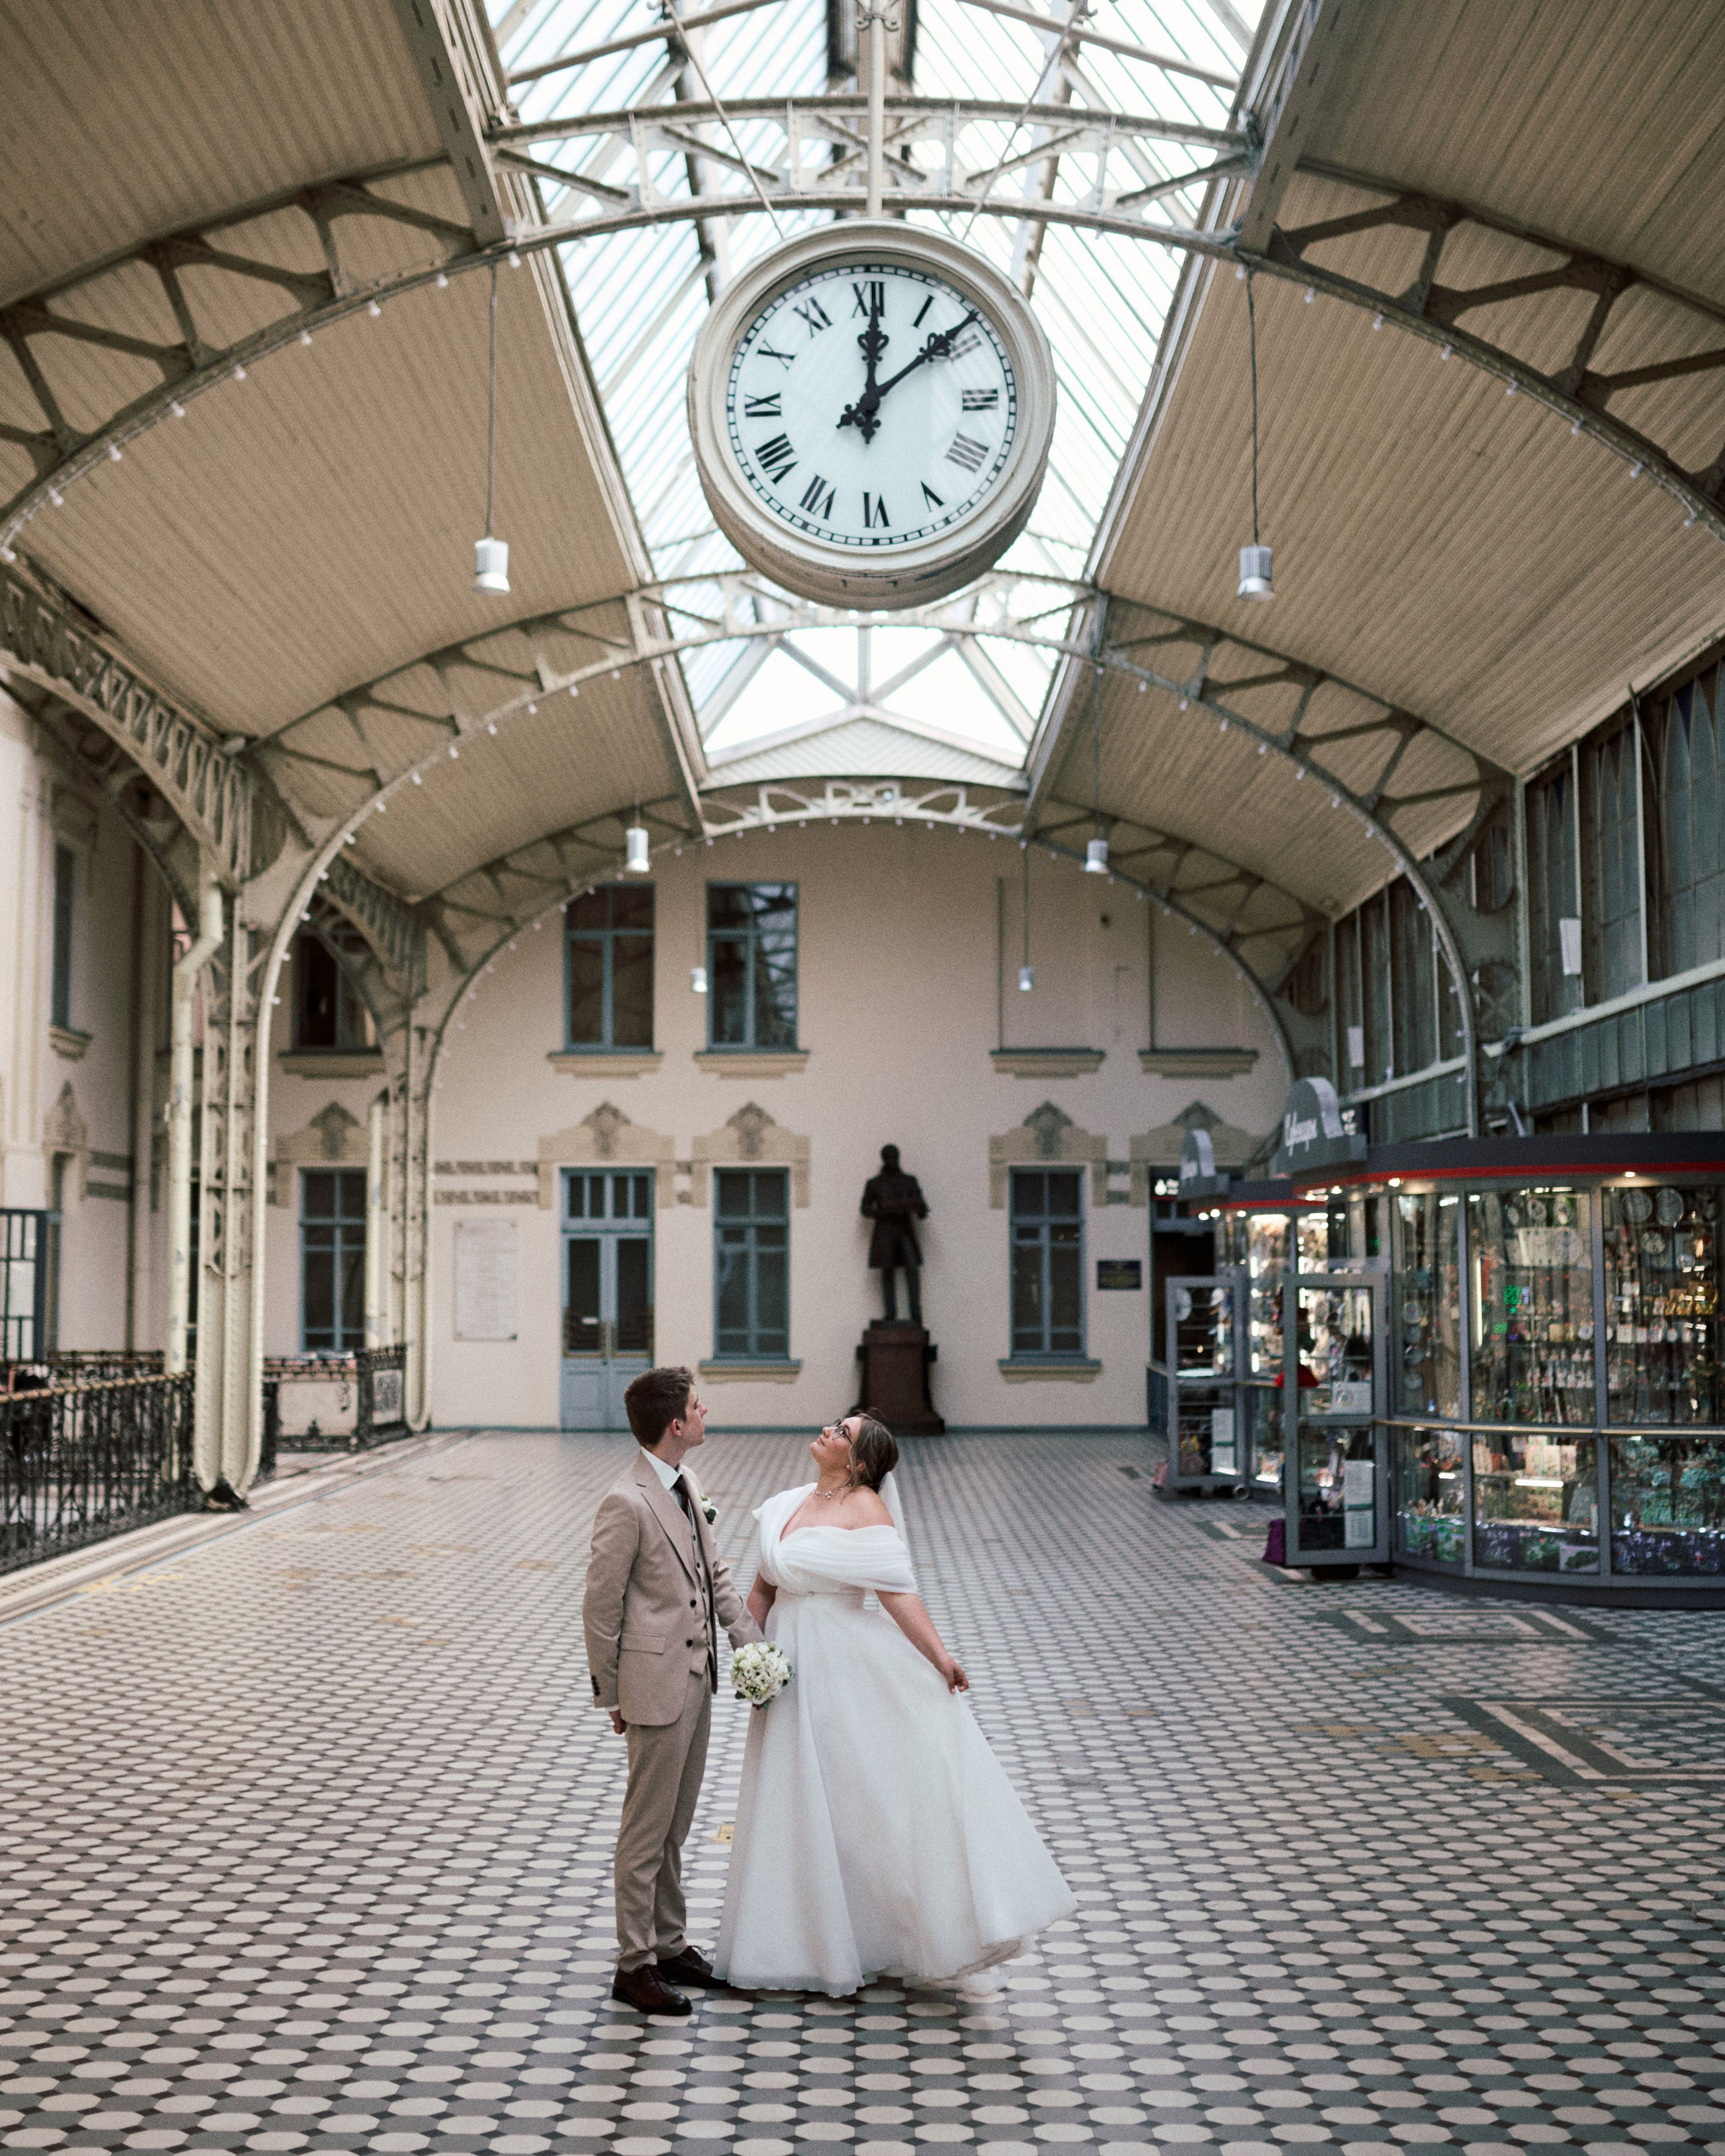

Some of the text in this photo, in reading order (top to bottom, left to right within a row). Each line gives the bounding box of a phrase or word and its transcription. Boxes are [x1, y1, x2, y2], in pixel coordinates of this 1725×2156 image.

[792, 296, 834, 338] XI
[911, 294, 936, 328] I
[757, 340, 796, 370] X
[745, 392, 782, 418] IX
[962, 389, 999, 412] III
[755, 433, 800, 486] VIII
[945, 433, 990, 473] IIII
[799, 474, 837, 521] VII
[862, 491, 892, 528] VI
[920, 479, 945, 512] V
